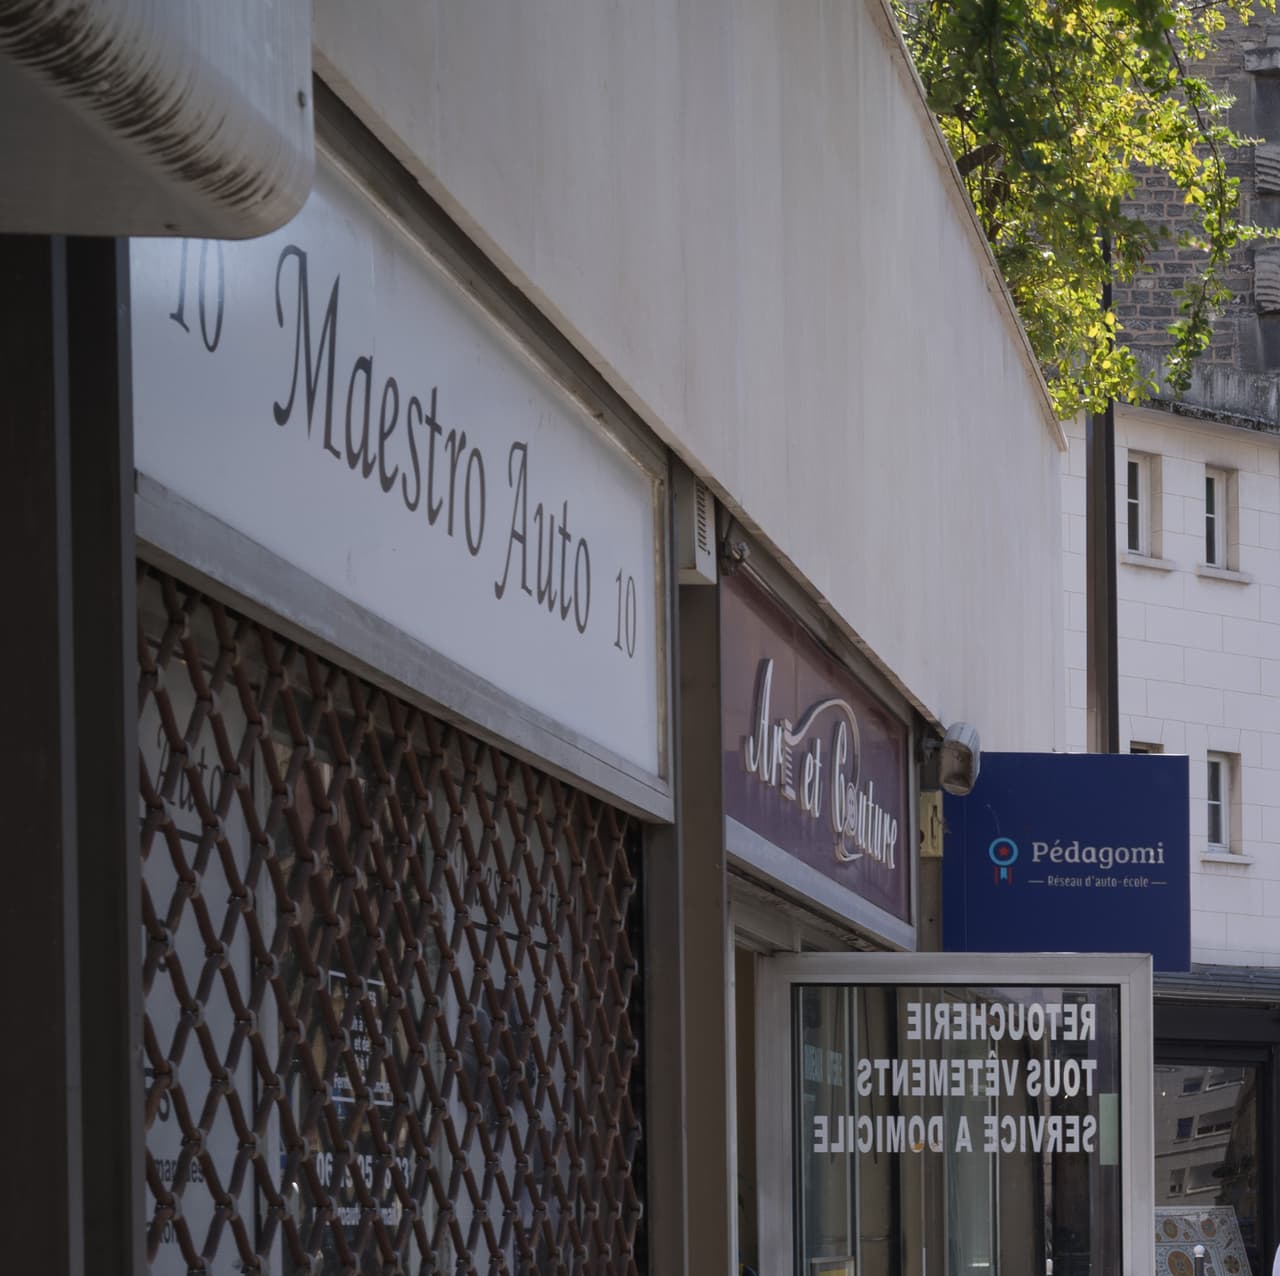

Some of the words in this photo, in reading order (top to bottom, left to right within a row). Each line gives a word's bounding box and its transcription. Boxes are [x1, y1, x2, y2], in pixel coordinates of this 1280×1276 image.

[273, 244, 486, 556] Maestro
[494, 441, 591, 634] Auto
[614, 568, 637, 659] 10
[801, 737, 822, 818] et
[832, 720, 898, 869] Couture
[1031, 840, 1165, 869] Pédagomi
[1047, 875, 1083, 888] Réseau
[1085, 876, 1149, 888] d'auto-école
